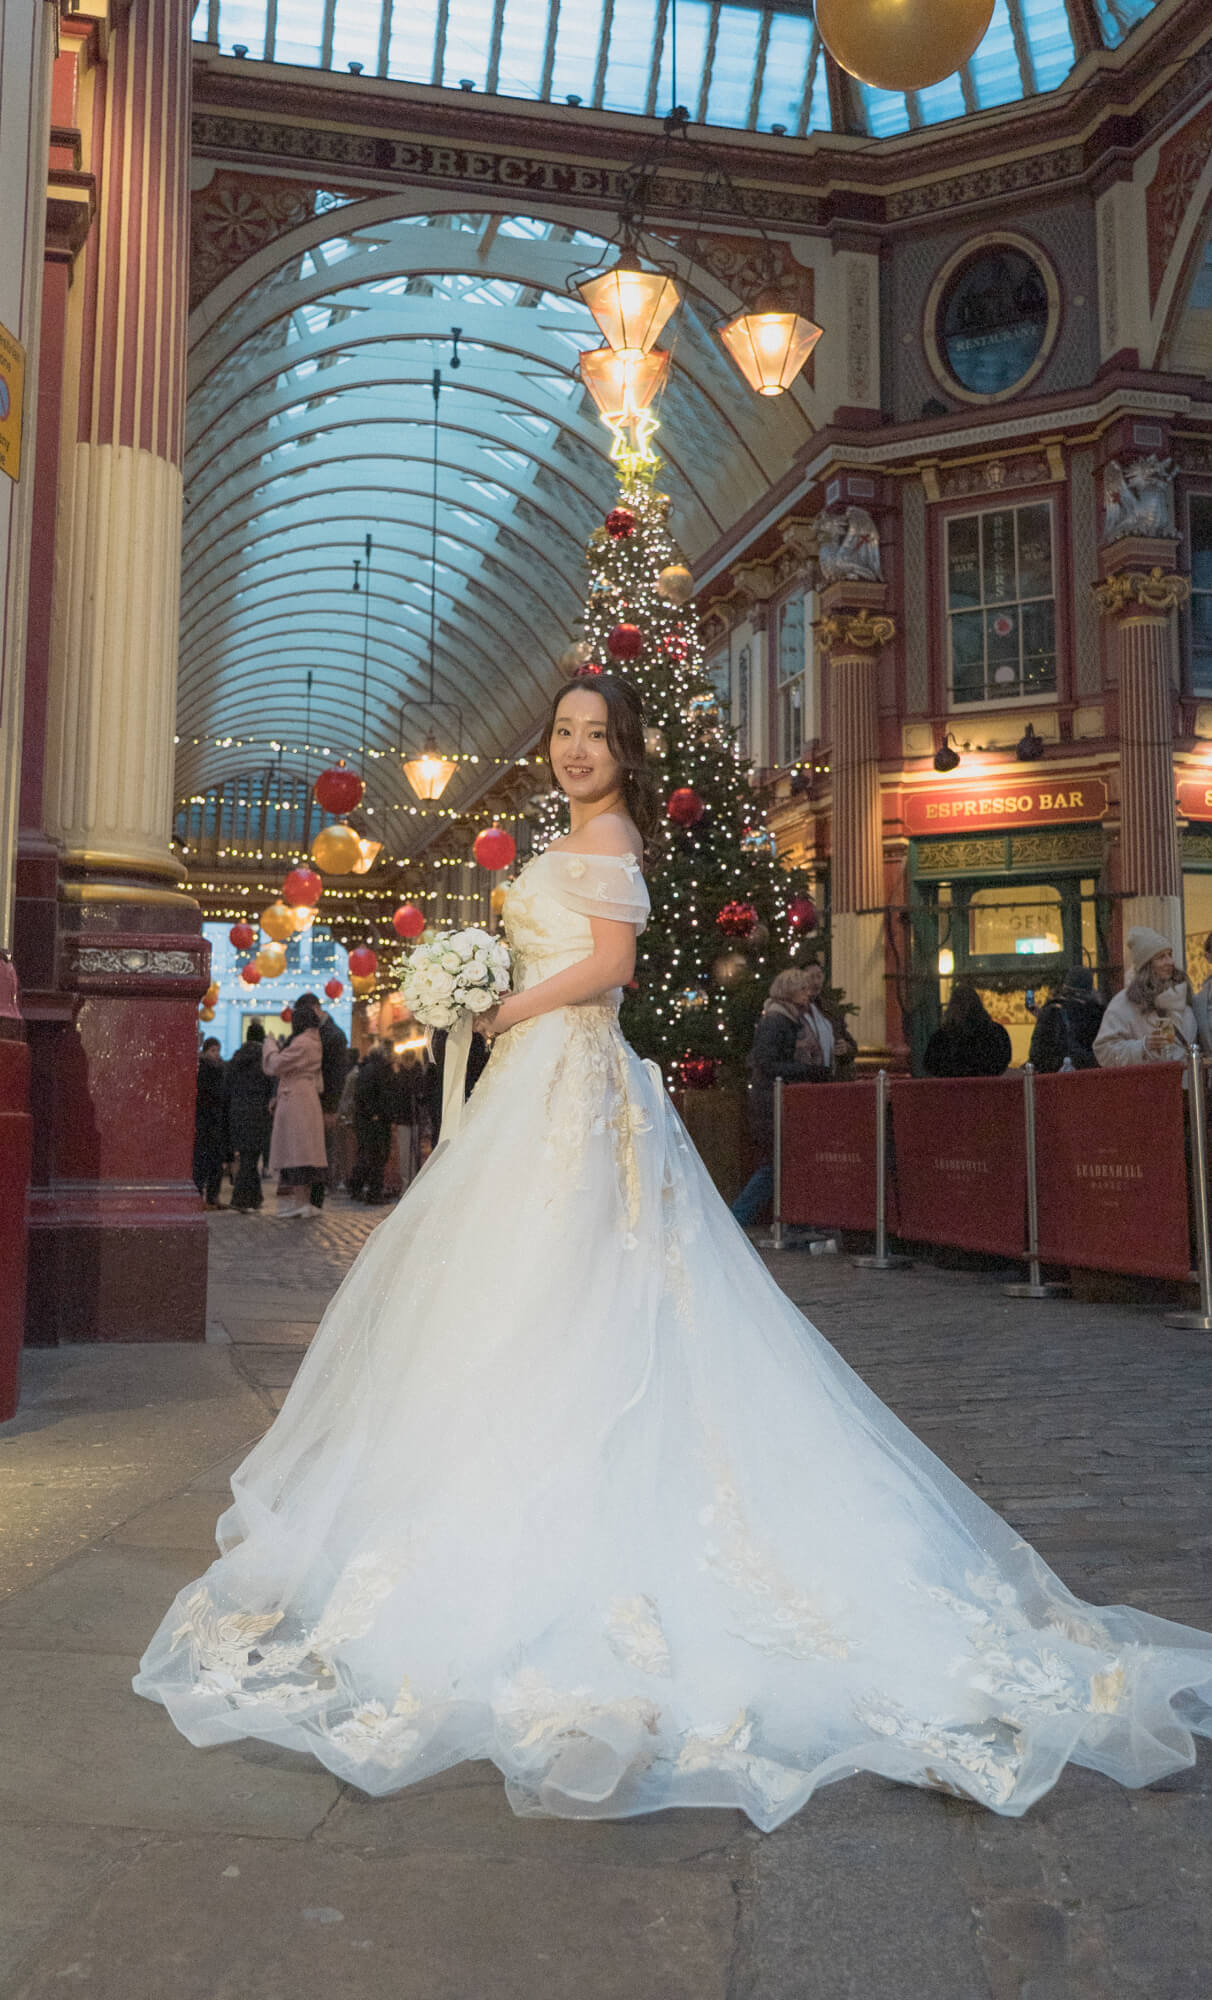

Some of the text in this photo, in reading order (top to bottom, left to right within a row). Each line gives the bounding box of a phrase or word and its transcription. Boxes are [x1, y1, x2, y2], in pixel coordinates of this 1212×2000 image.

[390, 142, 633, 197] ERECTED
[925, 791, 1084, 819] ESPRESSO BAR
[1076, 1164, 1144, 1178] LEADENHALL
